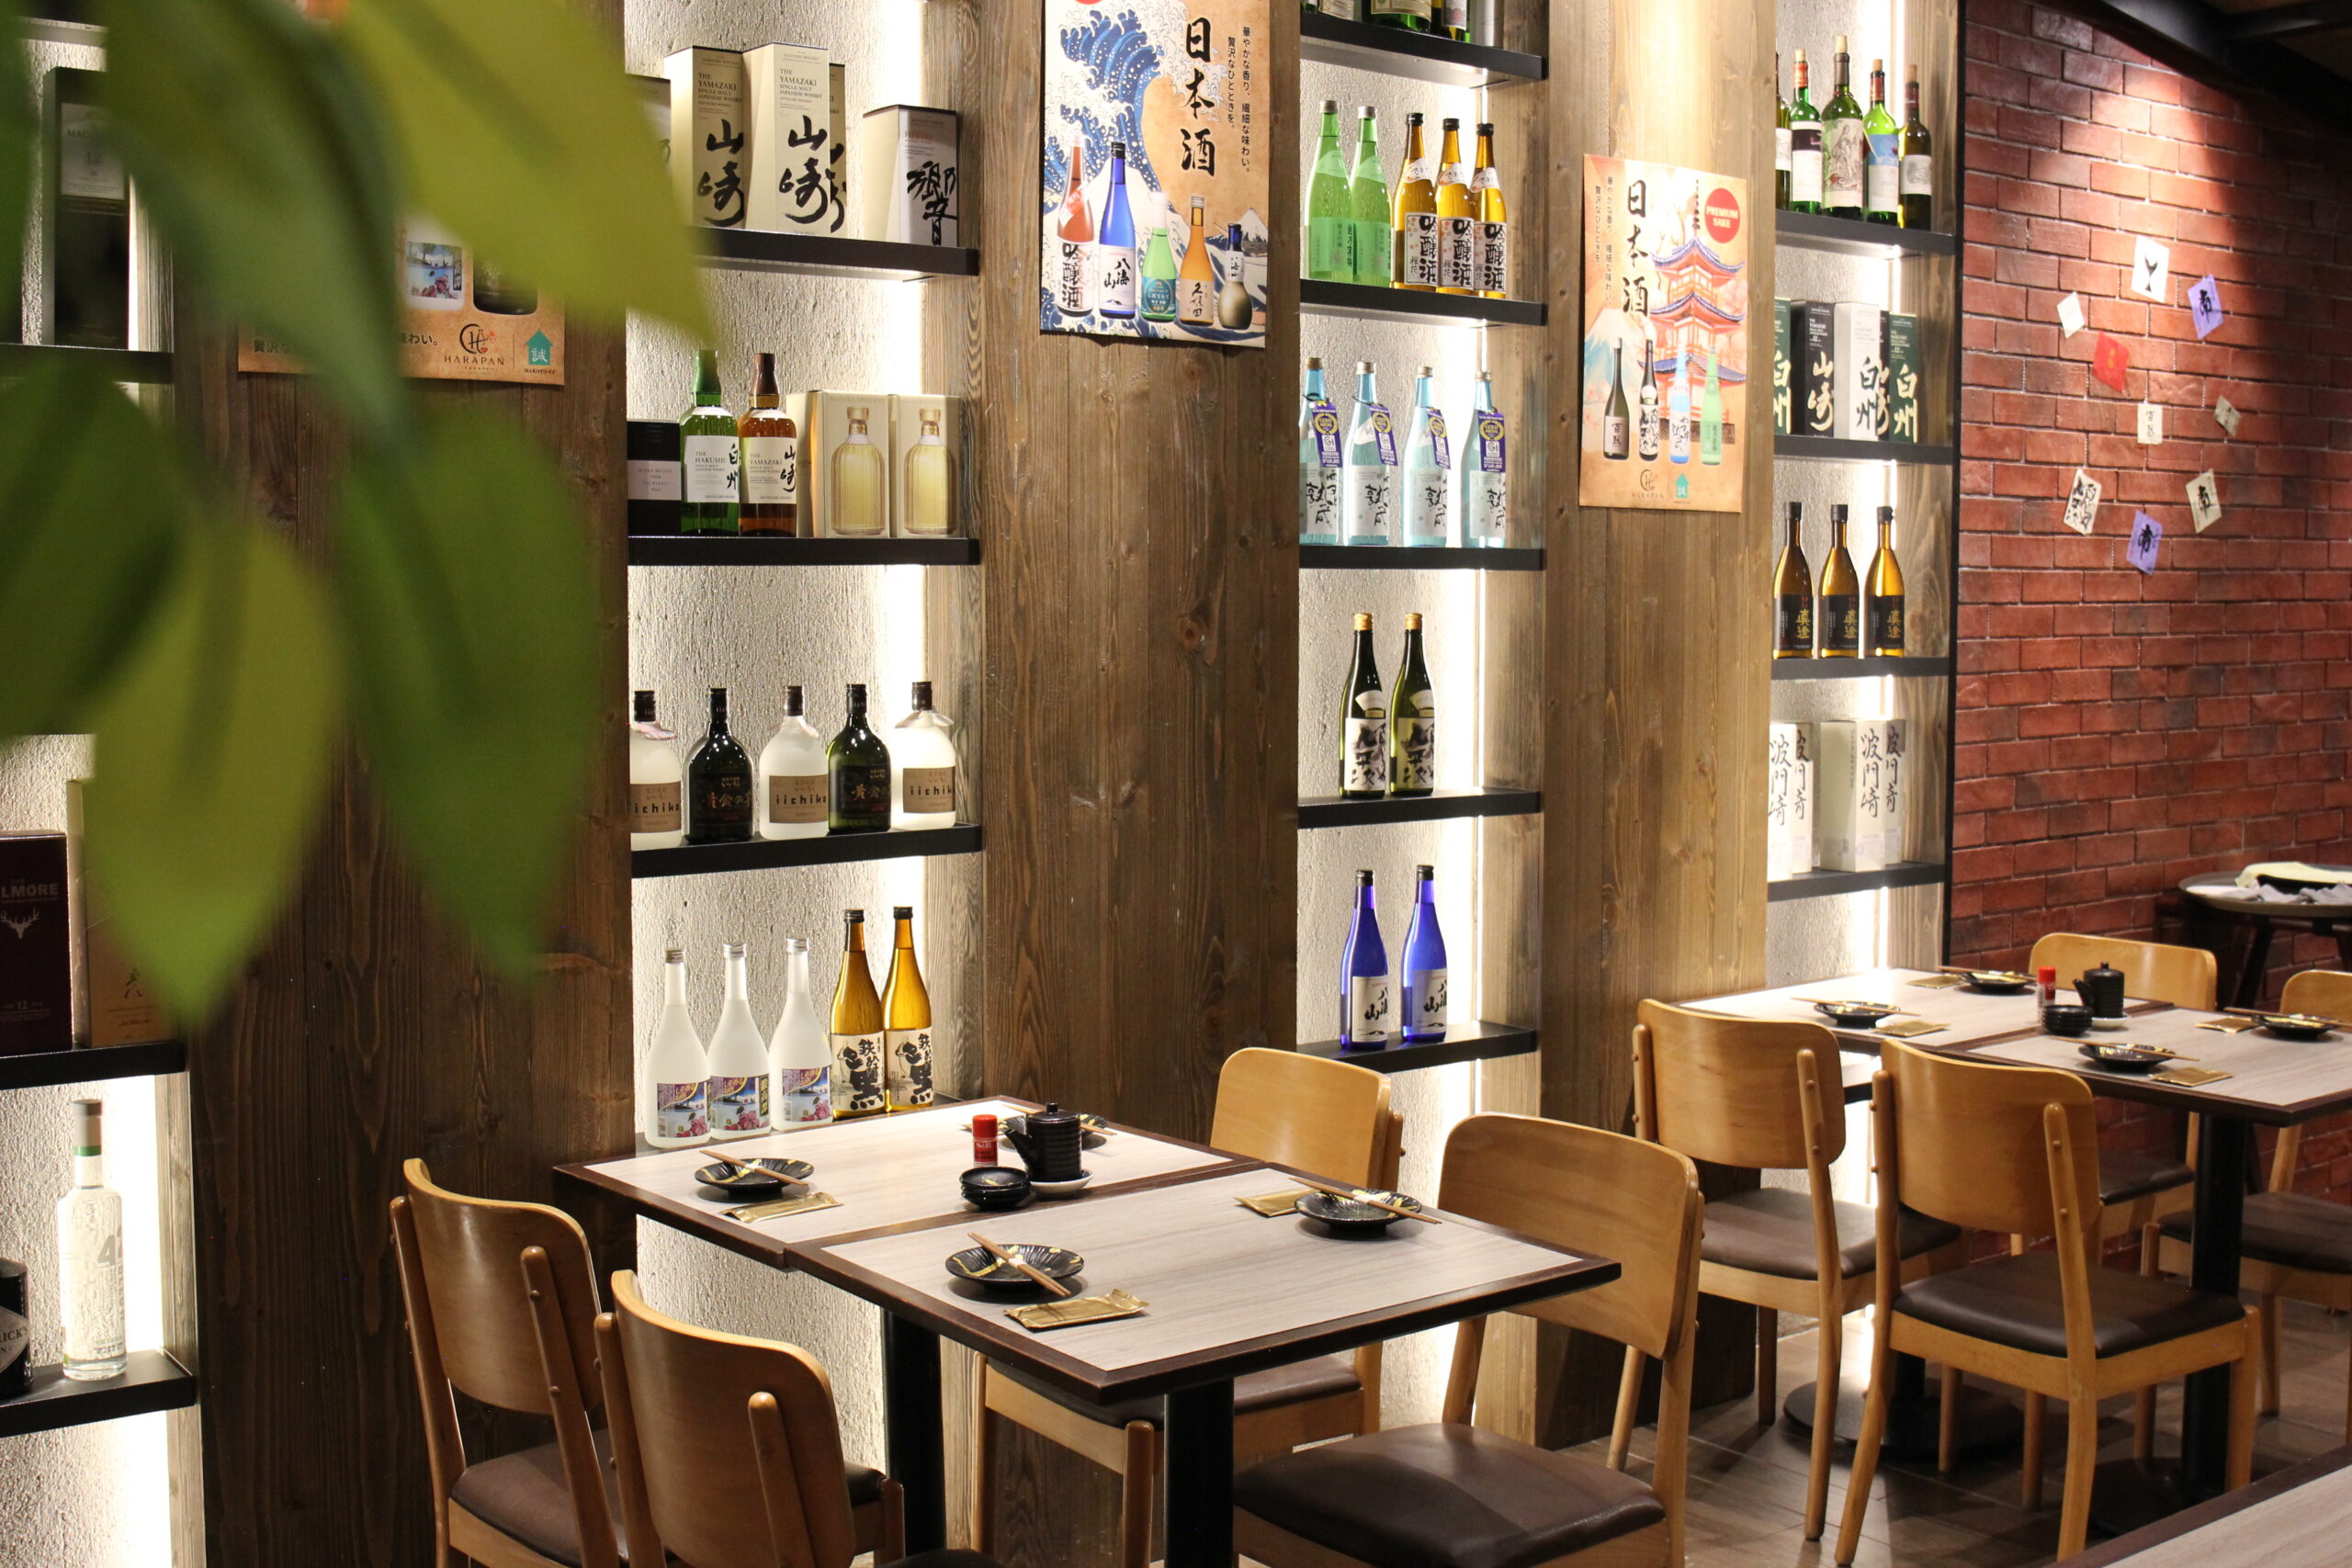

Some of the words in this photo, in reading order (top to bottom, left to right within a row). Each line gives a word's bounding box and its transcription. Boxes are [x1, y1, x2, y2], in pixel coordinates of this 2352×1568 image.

[698, 81, 737, 91] YAMAZAKI
[780, 76, 817, 86] YAMAZAKI
[1180, 17, 1216, 176] 日本酒
[779, 115, 828, 224] 山崎
[1706, 206, 1739, 219] PREMIUM
[1713, 218, 1732, 229] SAKE
[1622, 180, 1649, 317] 日本酒
[444, 355, 504, 366] HARAPAN
[531, 348, 548, 363] 誠
[1, 883, 59, 898] LMORE
